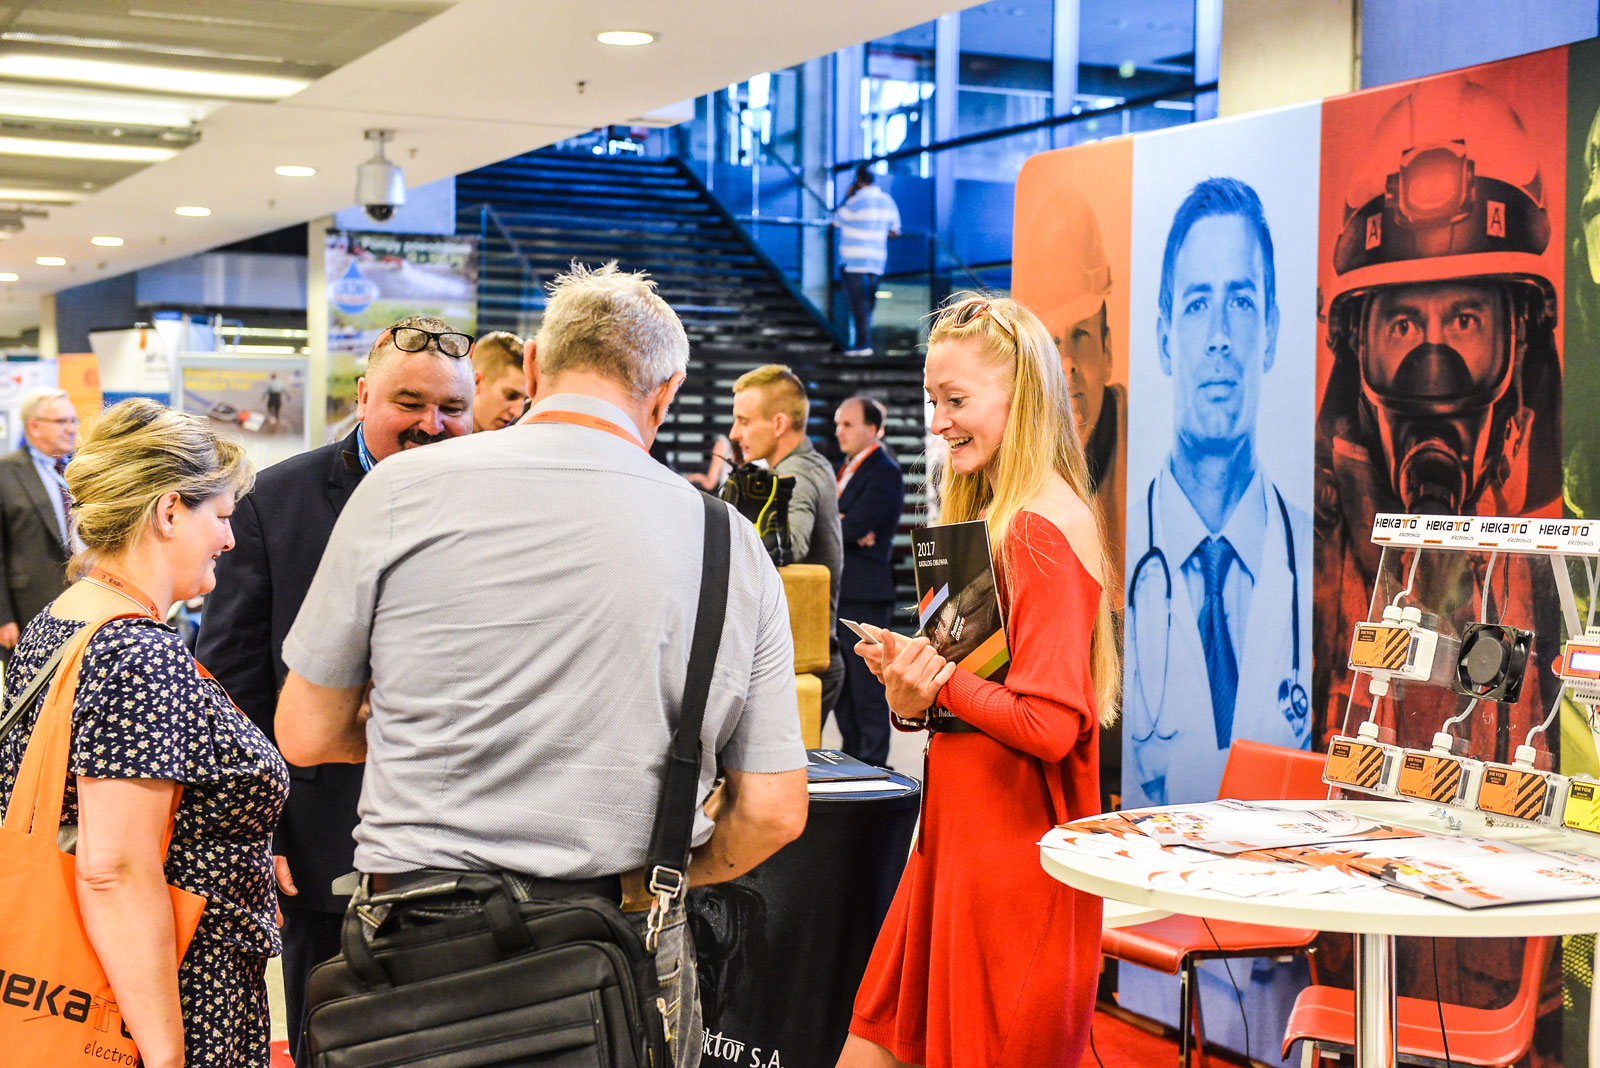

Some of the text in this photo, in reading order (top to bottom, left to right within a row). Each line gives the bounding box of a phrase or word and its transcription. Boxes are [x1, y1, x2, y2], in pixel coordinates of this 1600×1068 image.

[1490, 208, 1502, 230] A
[1368, 220, 1378, 243] A
[917, 541, 936, 557] 2017
[702, 1027, 745, 1063] ktor
